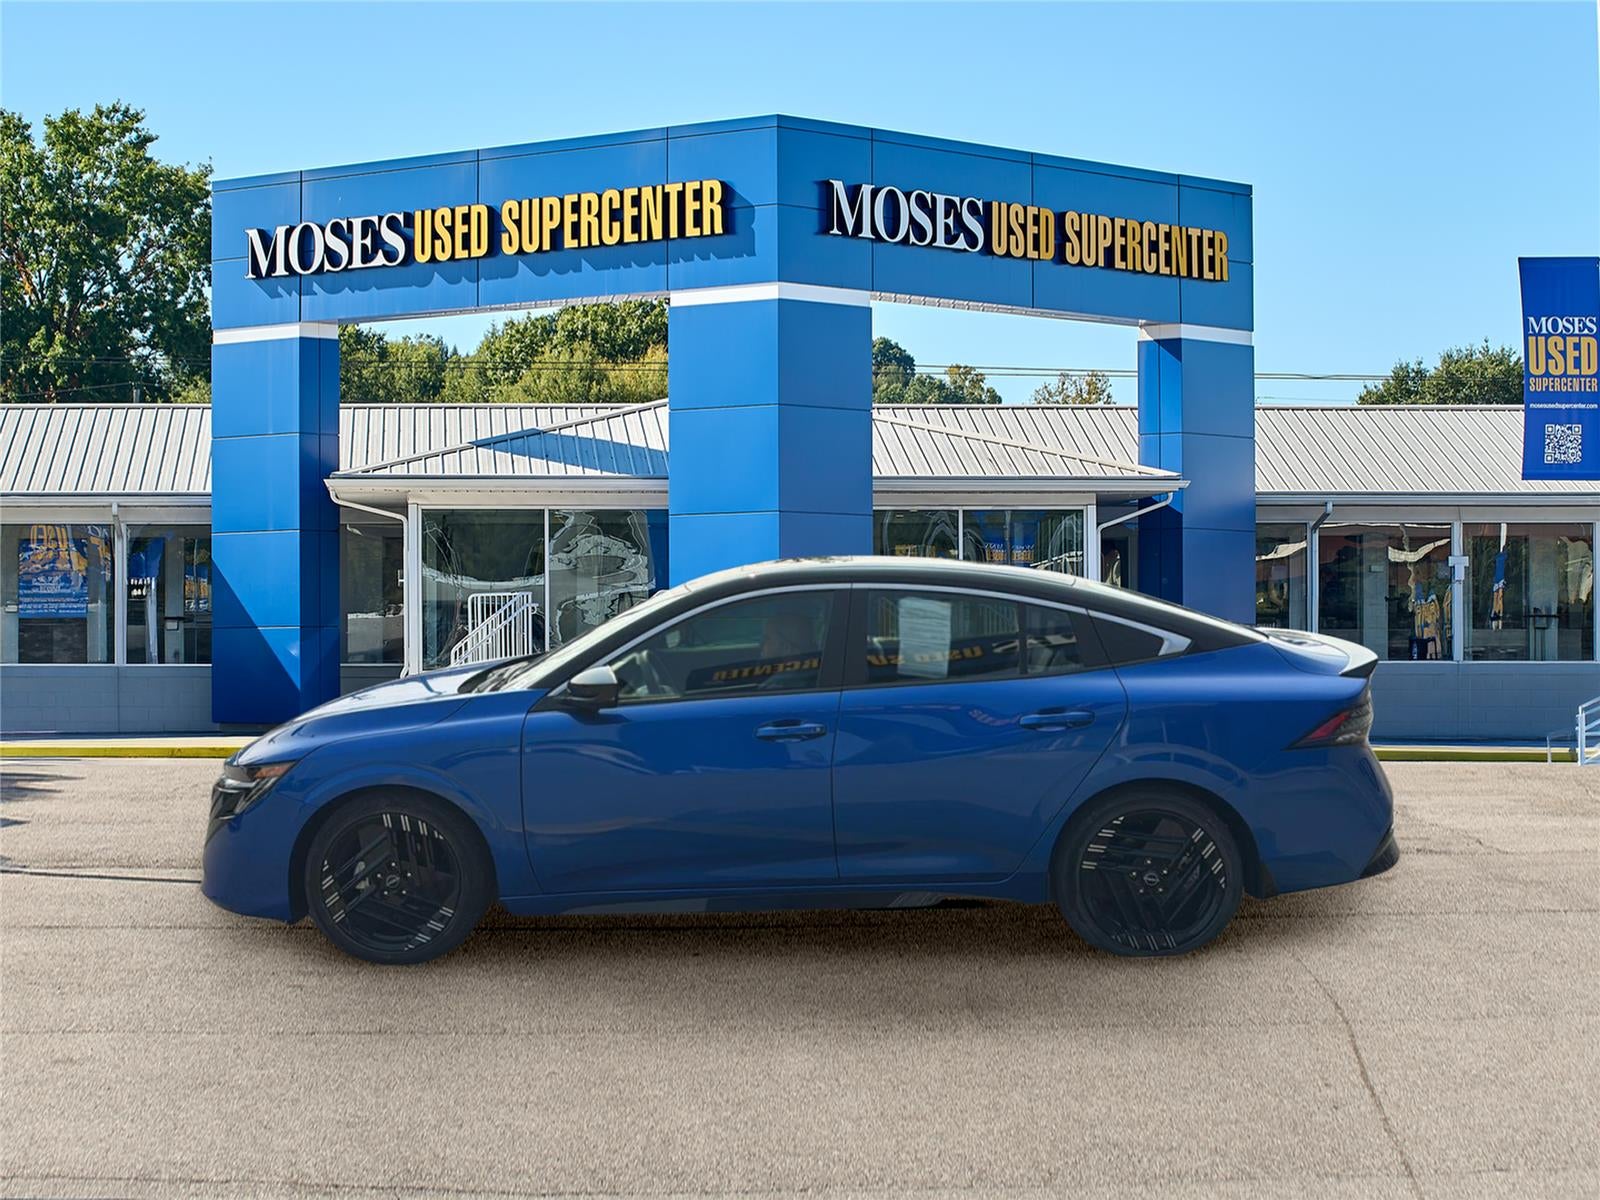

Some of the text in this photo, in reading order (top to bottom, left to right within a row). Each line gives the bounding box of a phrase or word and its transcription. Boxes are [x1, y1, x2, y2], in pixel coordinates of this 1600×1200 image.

[244, 179, 723, 280] MOSES USED SUPERCENTER
[827, 179, 1229, 281] MOSES USED SUPERCENTER
[1527, 316, 1597, 334] MOSES
[1528, 336, 1598, 376] USED
[1529, 377, 1598, 392] SUPERCENTER
